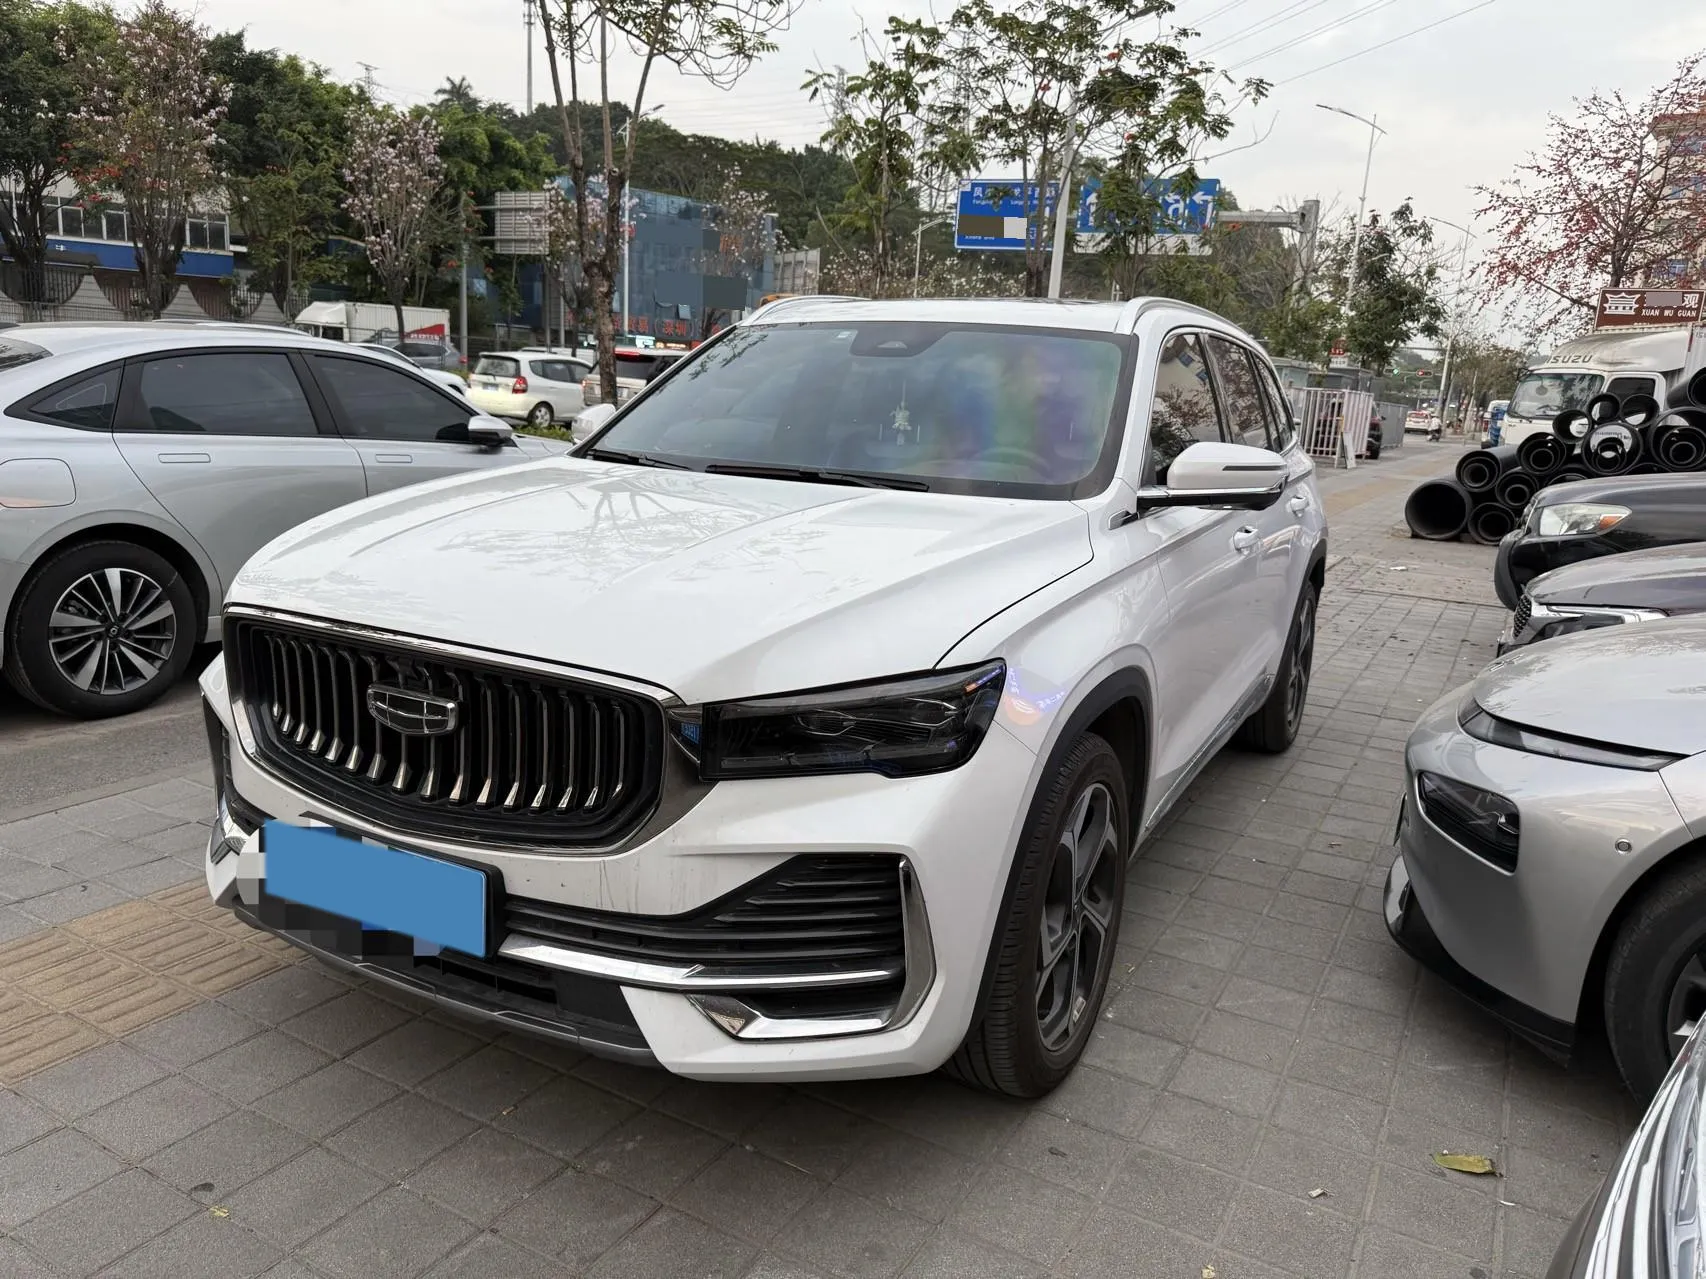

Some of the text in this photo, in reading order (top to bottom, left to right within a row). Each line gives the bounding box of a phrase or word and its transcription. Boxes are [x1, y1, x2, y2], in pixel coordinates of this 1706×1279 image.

[1641, 309, 1659, 317] XUAN
[1663, 309, 1674, 317] WU
[1547, 355, 1593, 364] ISUZU
